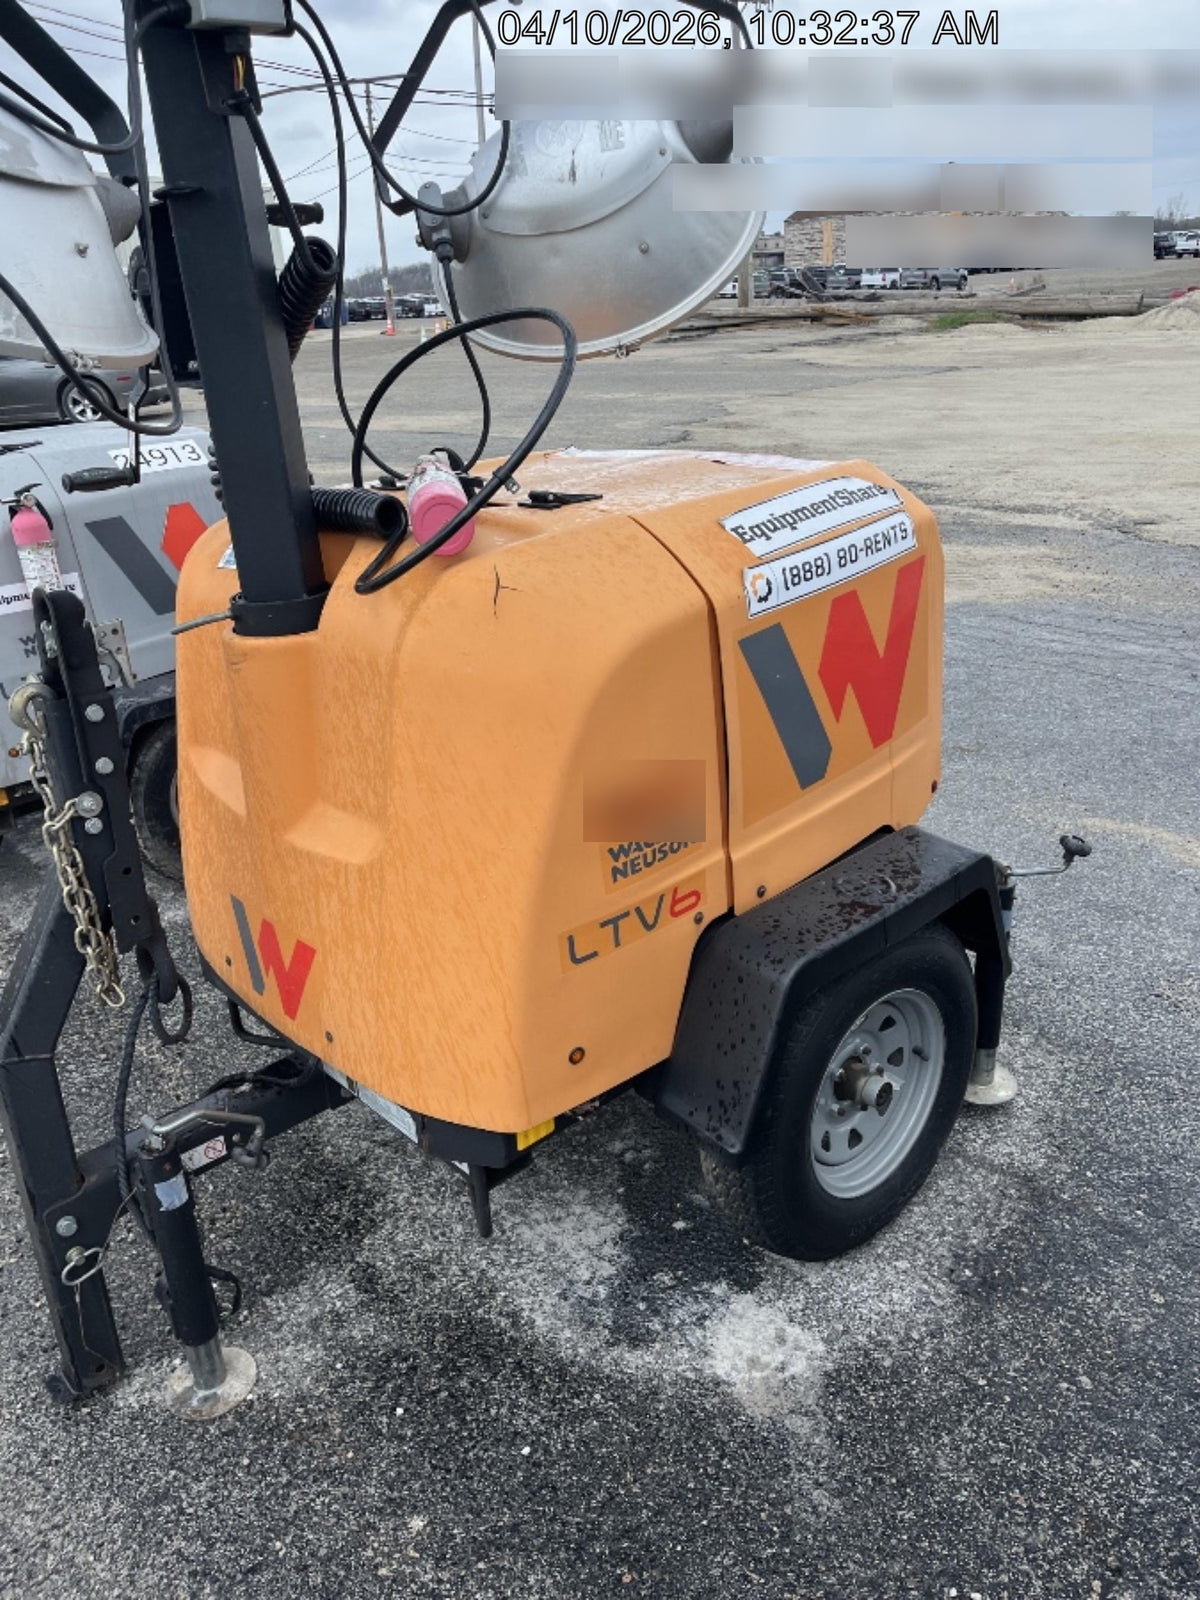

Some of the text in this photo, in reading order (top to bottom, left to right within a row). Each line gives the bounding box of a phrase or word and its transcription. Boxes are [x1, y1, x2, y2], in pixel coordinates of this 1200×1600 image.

[731, 484, 888, 544] EquipmentShare
[782, 521, 908, 591] (888) 80-RENTS
[567, 887, 701, 964] LTV6
